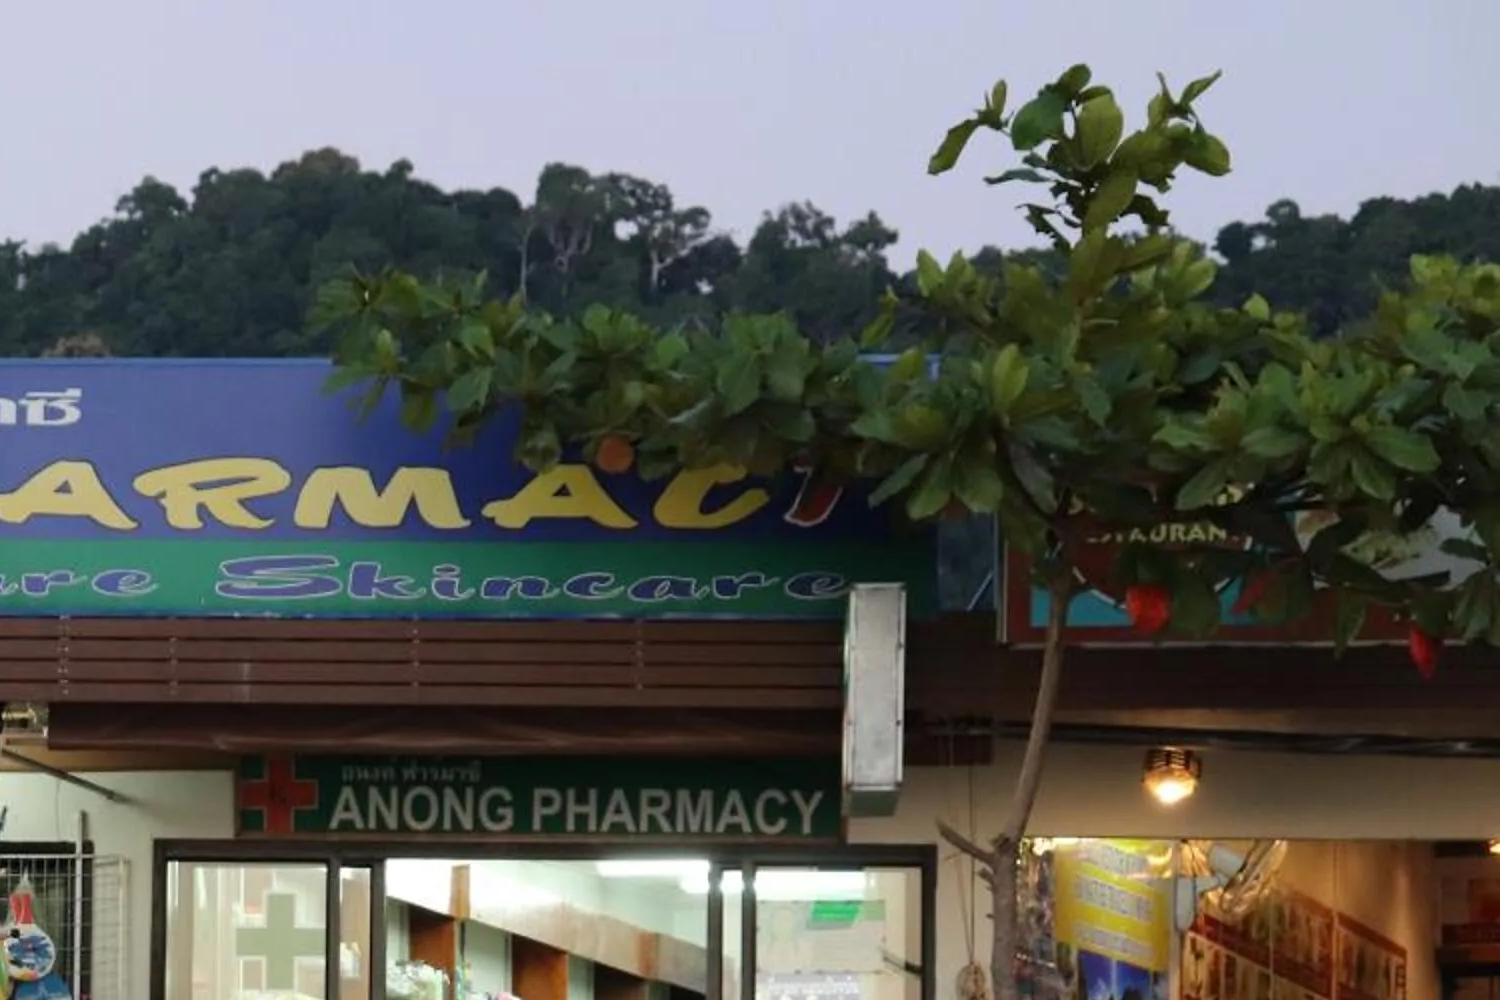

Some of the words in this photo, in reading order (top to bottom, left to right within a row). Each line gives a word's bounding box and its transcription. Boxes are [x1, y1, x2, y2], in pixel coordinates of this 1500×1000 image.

[215, 554, 851, 601] Skincare
[329, 785, 515, 832] ANONG
[531, 787, 825, 836] PHARMACY
